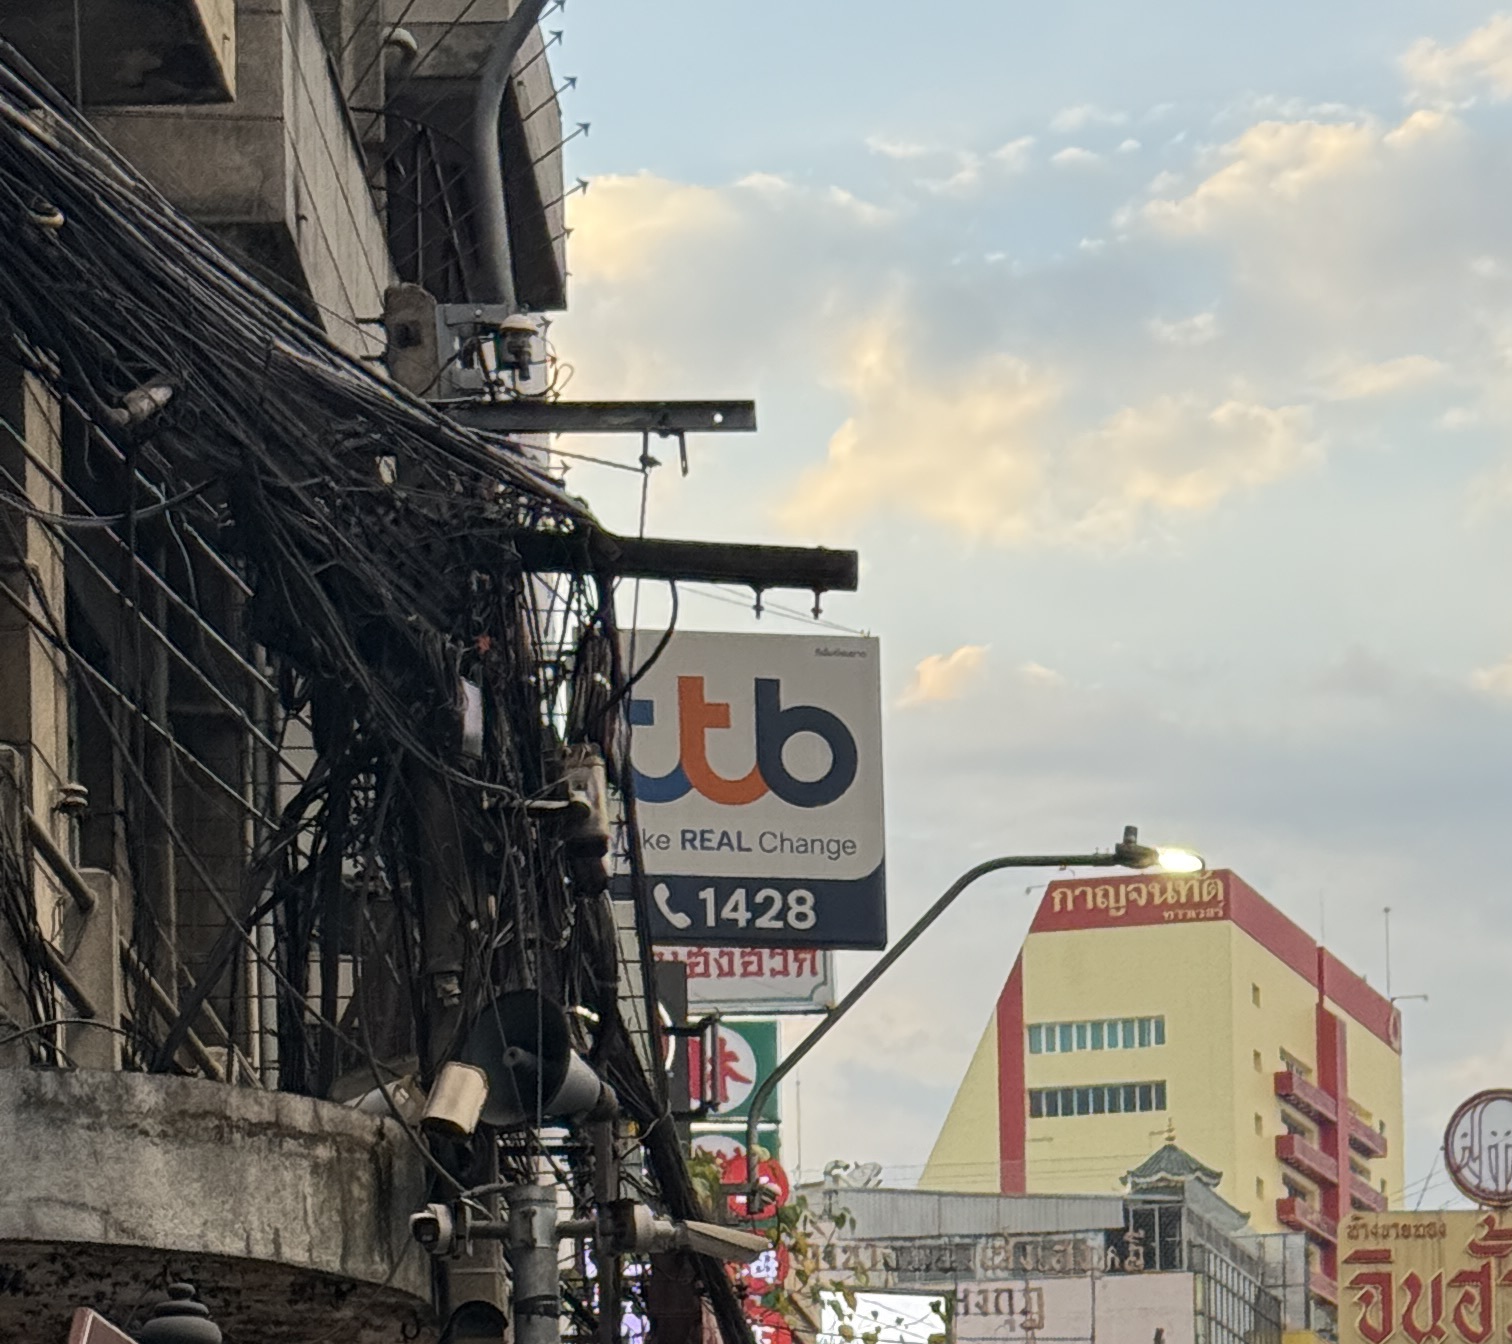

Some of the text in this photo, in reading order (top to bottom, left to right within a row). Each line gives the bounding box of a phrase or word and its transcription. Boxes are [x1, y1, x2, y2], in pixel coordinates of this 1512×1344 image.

[680, 828, 753, 853] REAL
[758, 831, 858, 862] Change
[698, 887, 817, 930] 1428
